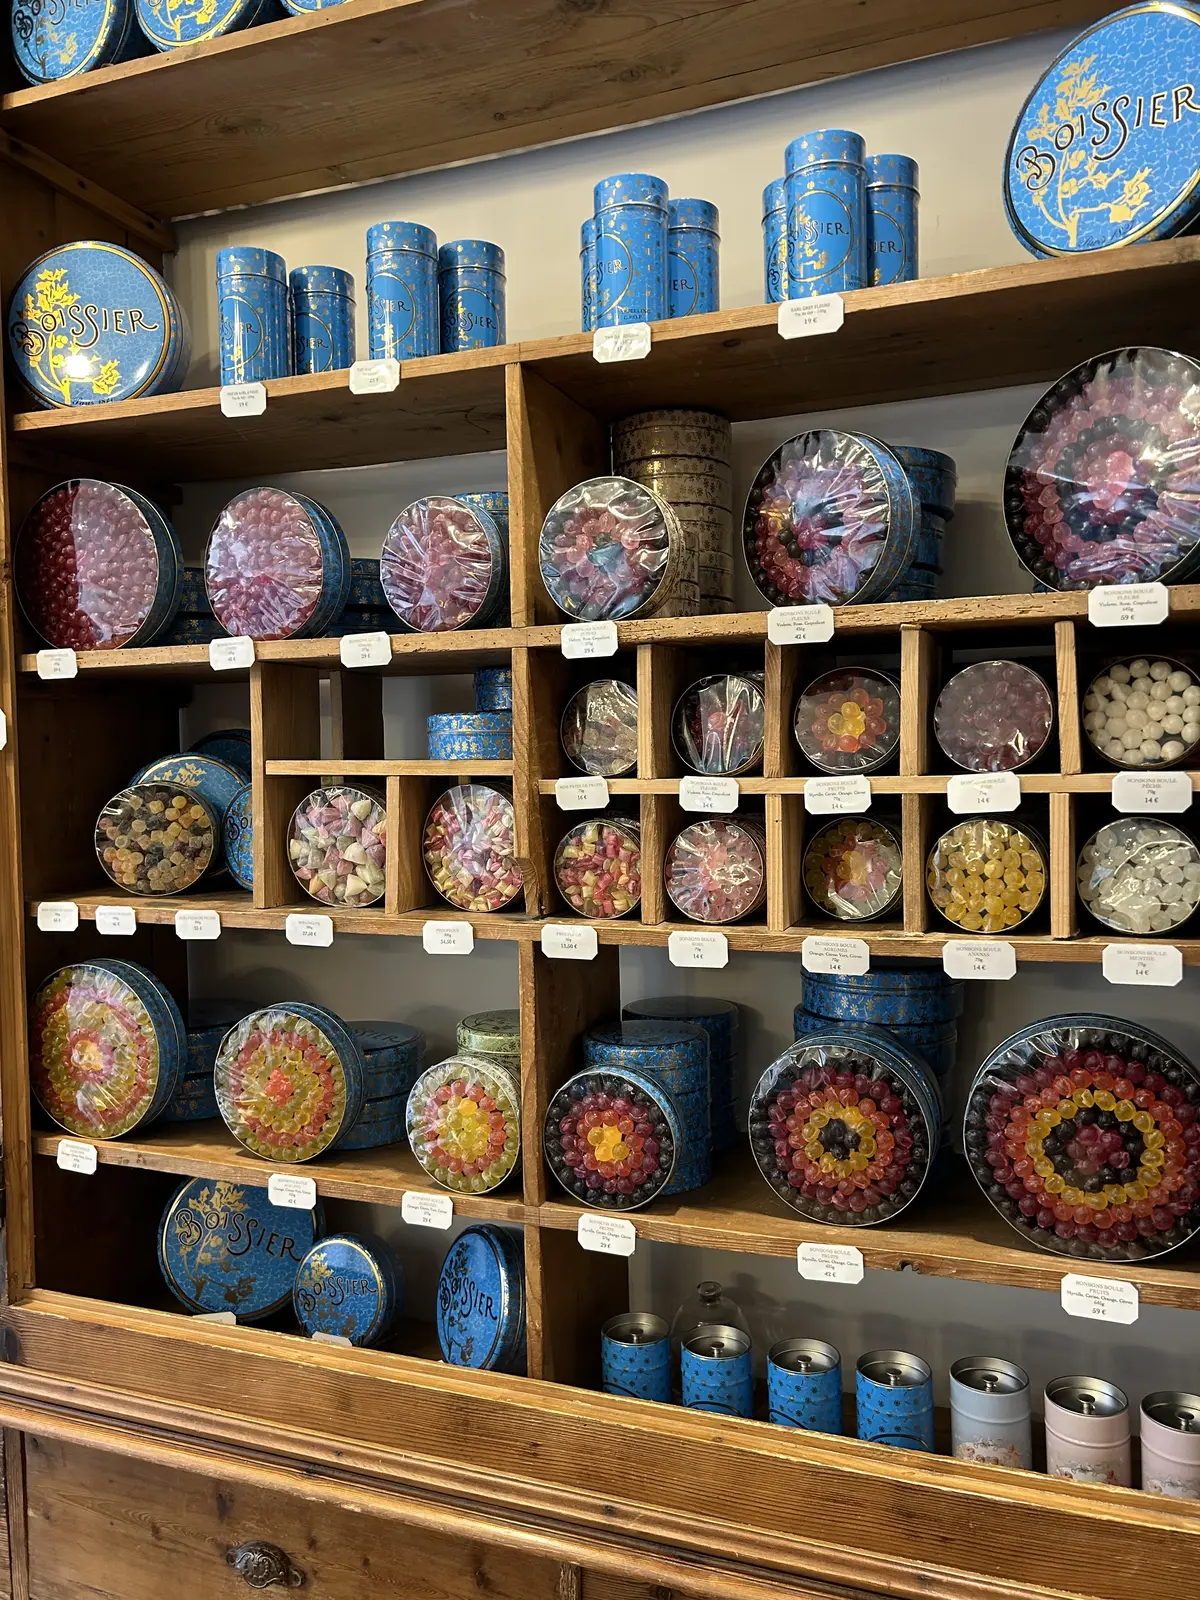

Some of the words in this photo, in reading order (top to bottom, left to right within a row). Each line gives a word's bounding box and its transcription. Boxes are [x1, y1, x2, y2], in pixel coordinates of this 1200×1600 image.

[1016, 84, 1200, 191] BOISSIER
[11, 304, 159, 357] BOISSIER
[175, 1208, 302, 1262] BOISSIER
[297, 1275, 377, 1312] BOISSIER
[440, 1276, 498, 1321] BOISSIER
